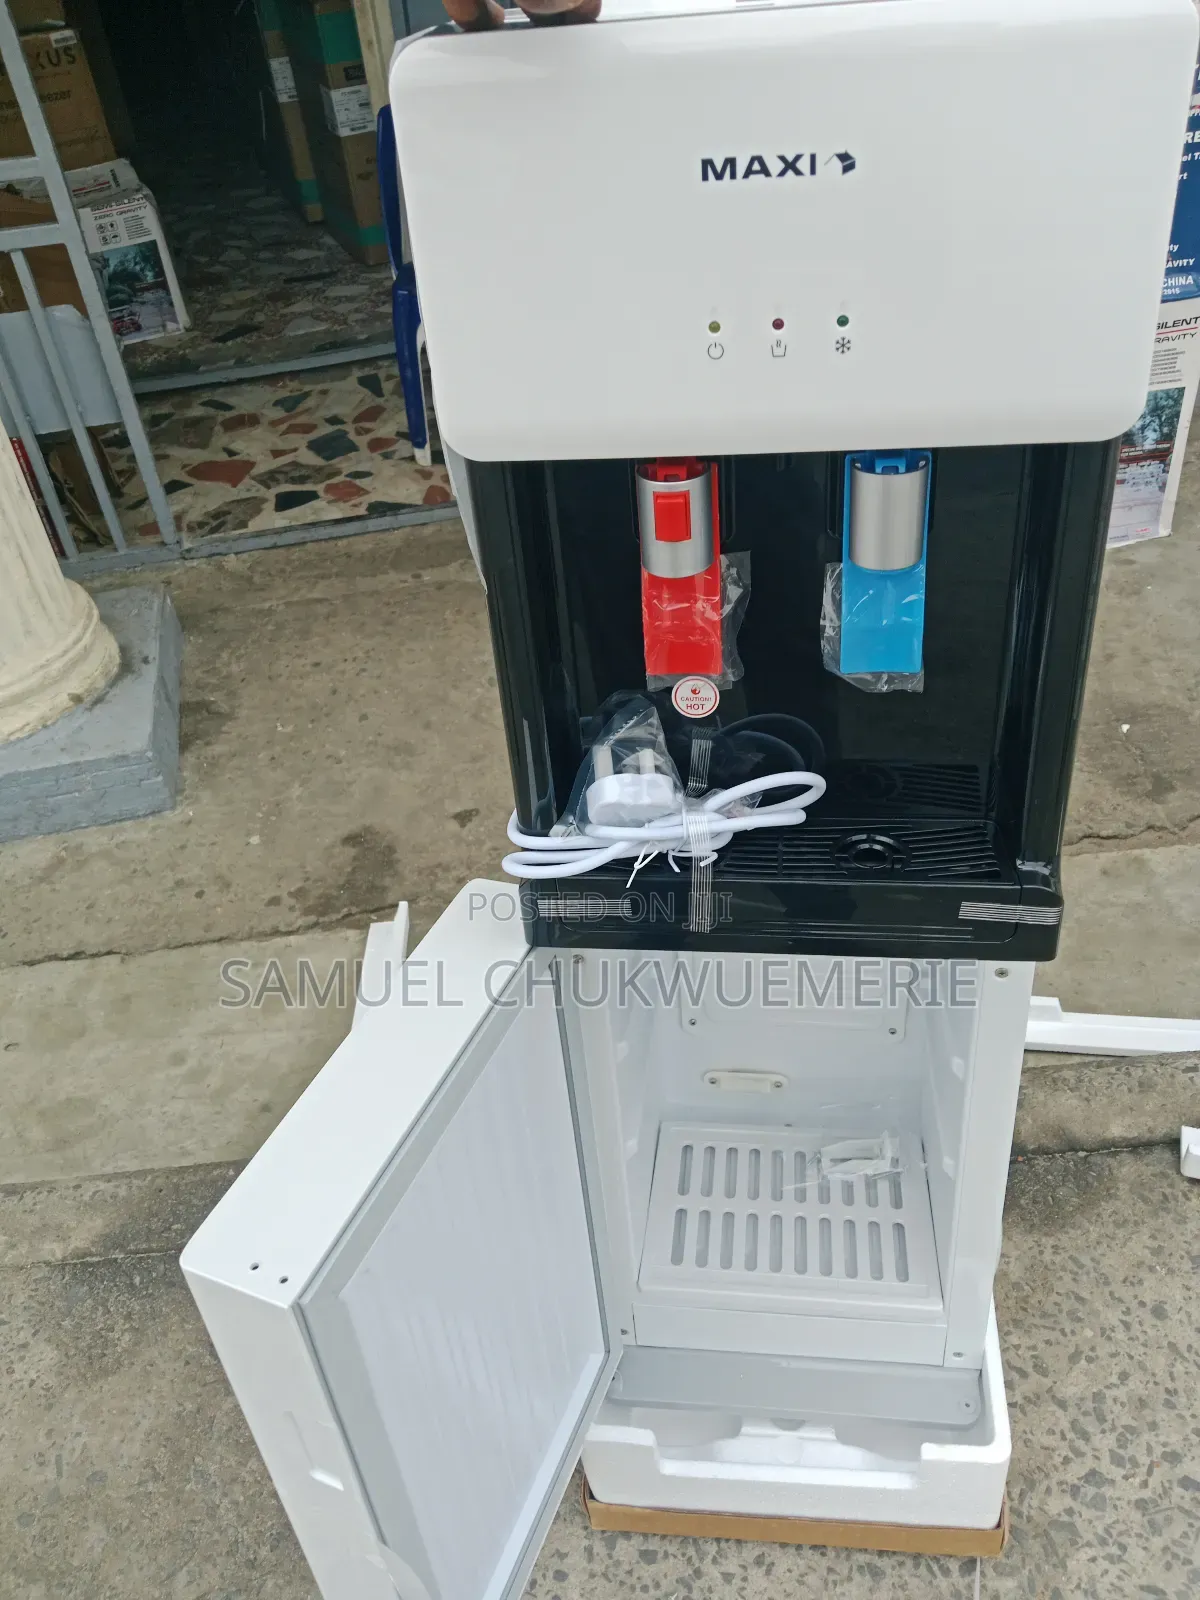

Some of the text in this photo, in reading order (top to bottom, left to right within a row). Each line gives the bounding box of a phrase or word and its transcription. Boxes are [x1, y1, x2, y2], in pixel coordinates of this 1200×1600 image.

[701, 153, 817, 182] MAXI
[1165, 257, 1196, 269] AVITY
[1154, 331, 1198, 344] RAVITY
[686, 703, 705, 711] HOT
